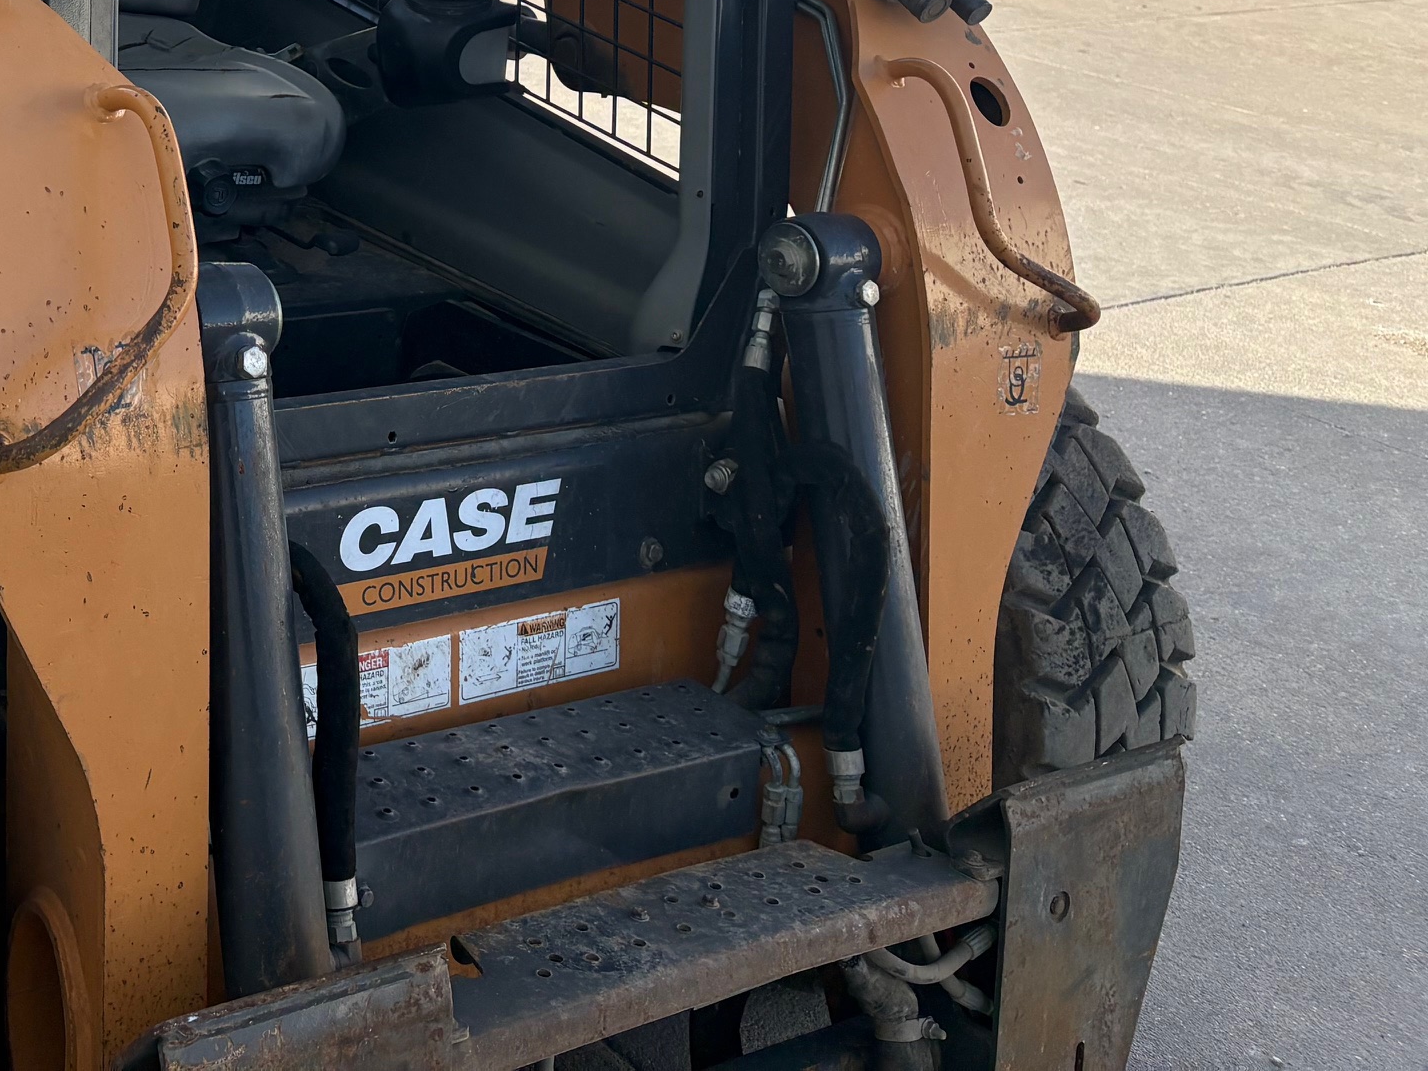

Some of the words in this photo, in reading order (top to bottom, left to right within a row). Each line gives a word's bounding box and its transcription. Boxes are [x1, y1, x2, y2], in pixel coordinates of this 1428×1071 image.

[232, 172, 262, 185] ilsco
[339, 478, 562, 572] CASE
[361, 554, 539, 606] CONSTRUCTION
[529, 617, 565, 633] WARNING
[521, 636, 537, 645] FALL
[538, 630, 564, 641] HAZARD
[359, 657, 383, 672] NGER
